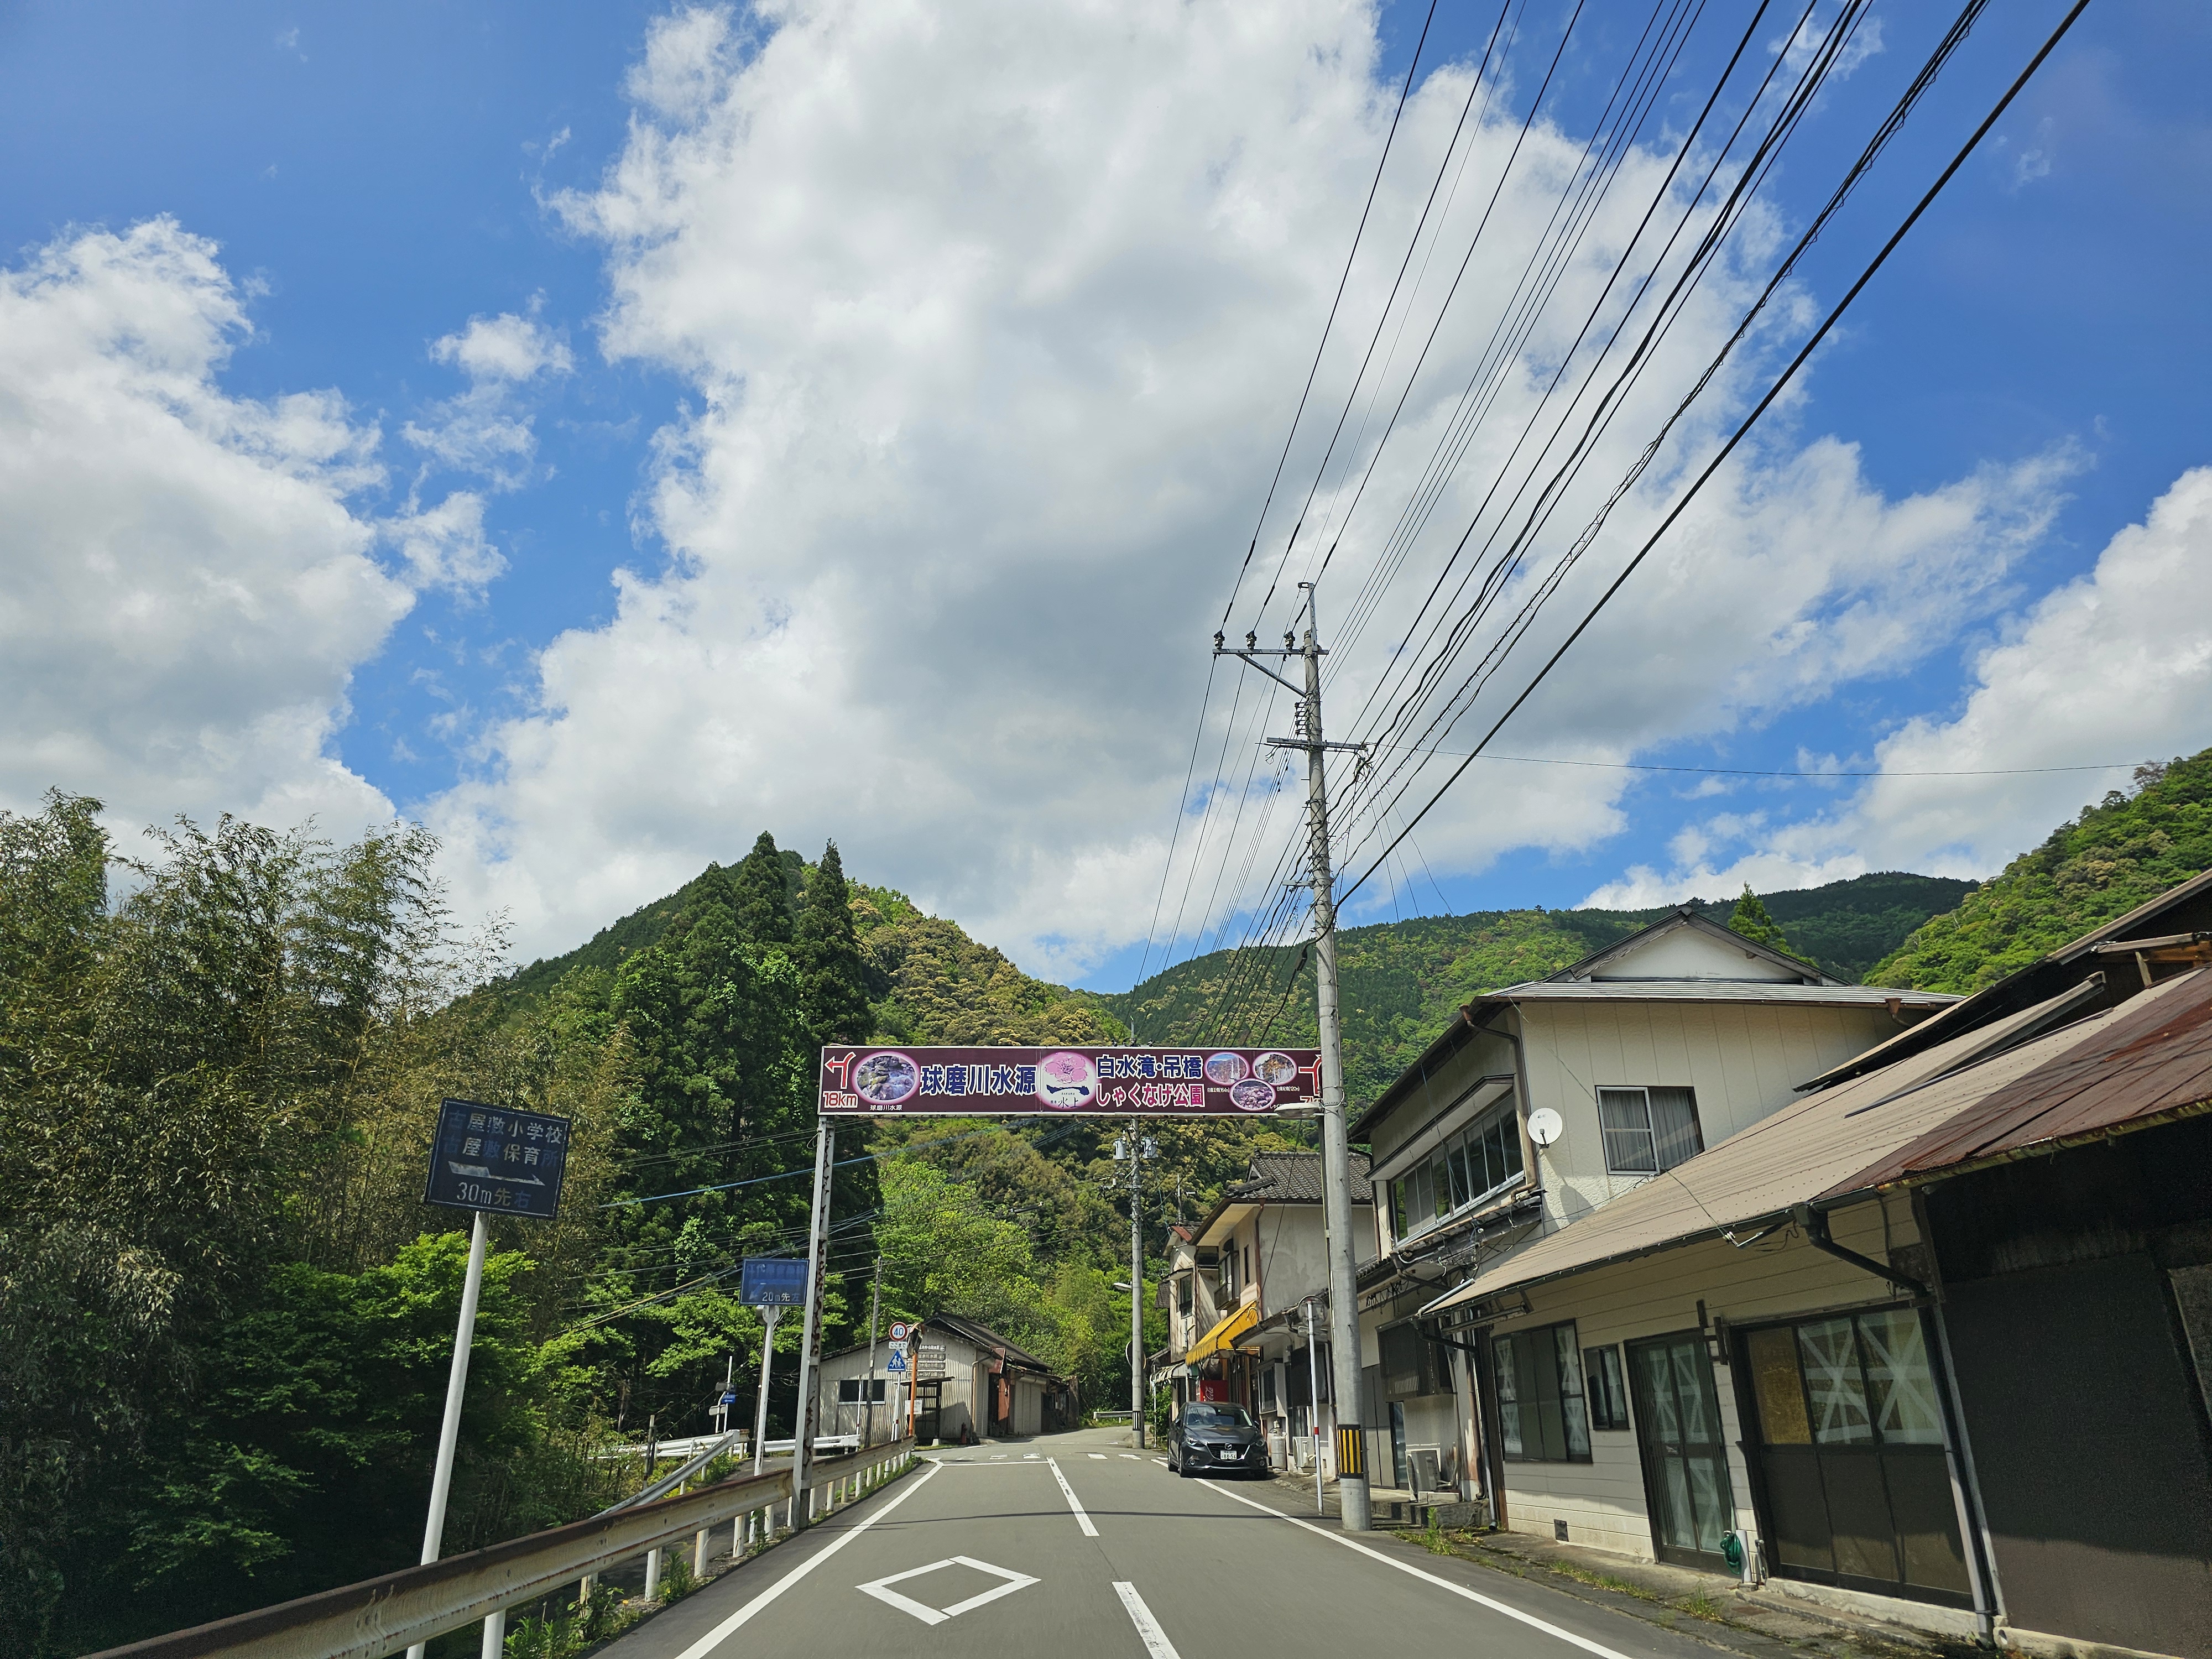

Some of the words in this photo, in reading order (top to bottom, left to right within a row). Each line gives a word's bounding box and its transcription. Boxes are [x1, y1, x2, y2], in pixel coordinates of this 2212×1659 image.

[1096, 1054, 1203, 1079] 白水滝・吊橋
[920, 1064, 1038, 1096] 球磨川水源
[823, 1091, 858, 1108] 18km
[1058, 1097, 1080, 1109] 水上
[1096, 1082, 1206, 1108] しゃくなげ公園
[448, 1110, 563, 1144] 古屋敷小学校
[894, 1328, 904, 1336] 40
